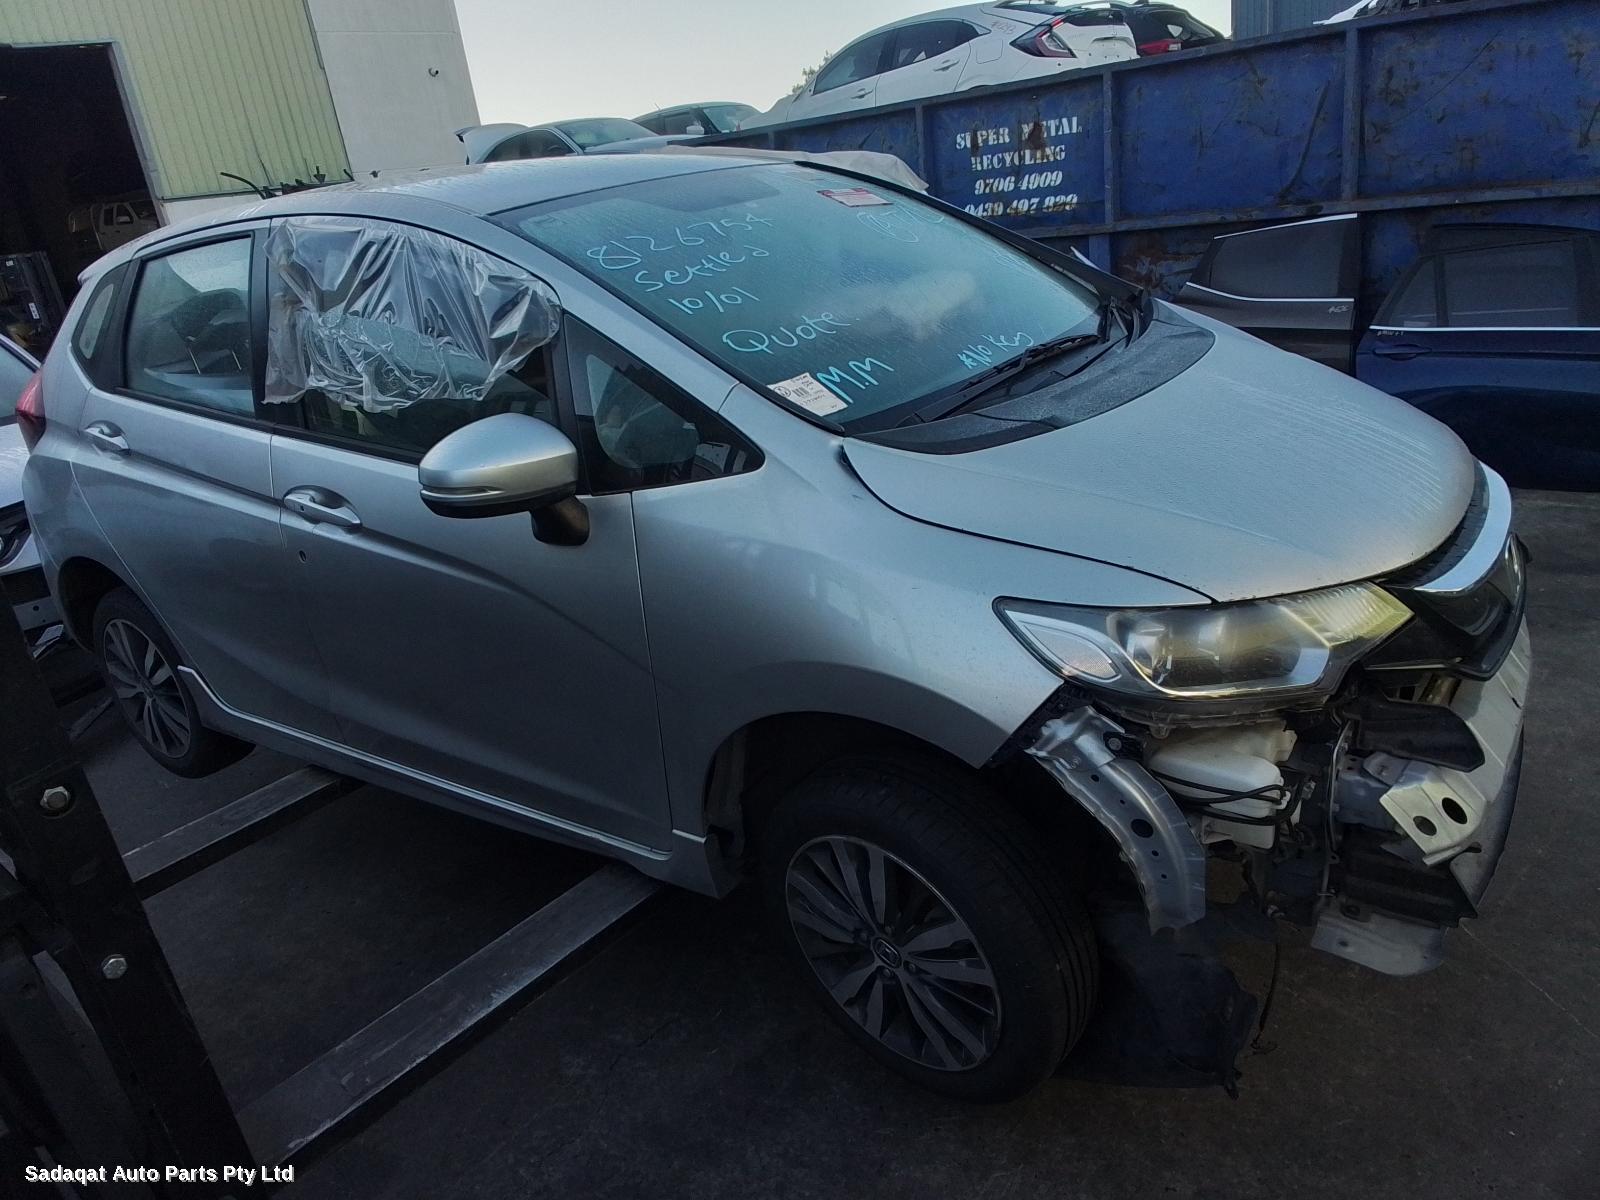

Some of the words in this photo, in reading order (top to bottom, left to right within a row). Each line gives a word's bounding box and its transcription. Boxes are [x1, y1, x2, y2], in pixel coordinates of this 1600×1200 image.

[955, 127, 1011, 150] SUPER
[970, 144, 1066, 171] RECYCLING
[974, 175, 1016, 195] 9706
[667, 286, 761, 315] 10/01
